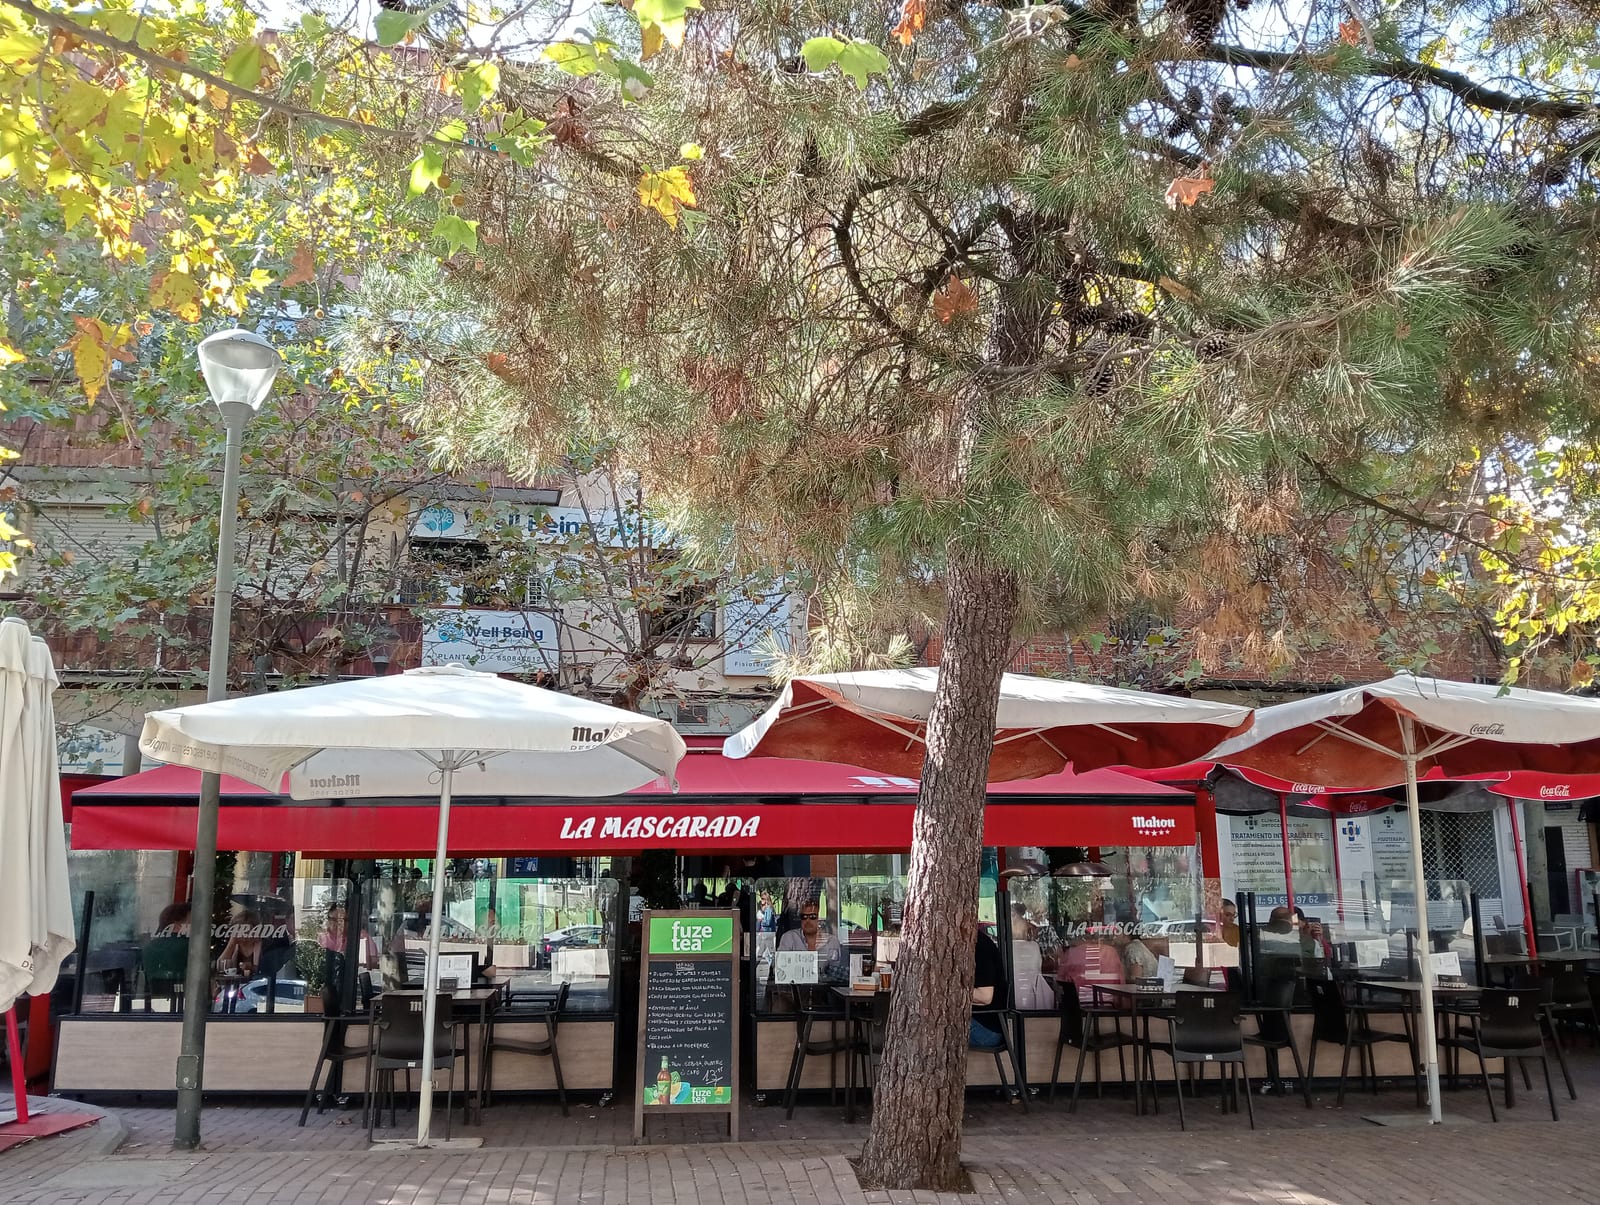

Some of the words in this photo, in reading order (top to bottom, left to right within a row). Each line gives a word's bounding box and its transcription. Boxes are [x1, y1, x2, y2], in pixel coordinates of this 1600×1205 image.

[467, 626, 498, 638] Well
[503, 626, 544, 641] Being
[560, 816, 596, 839] LA
[600, 815, 761, 839] MASCARADA
[1132, 815, 1176, 829] Mahou
[1267, 896, 1278, 904] 91
[1296, 895, 1306, 904] 97
[1308, 895, 1319, 904] 62
[151, 923, 175, 938] LA
[178, 923, 288, 939] MSCARADA
[672, 920, 713, 939] fuze
[1066, 921, 1086, 936] LA
[672, 937, 703, 951] tea
[692, 1087, 712, 1097] fuze
[692, 1096, 707, 1104] tea
